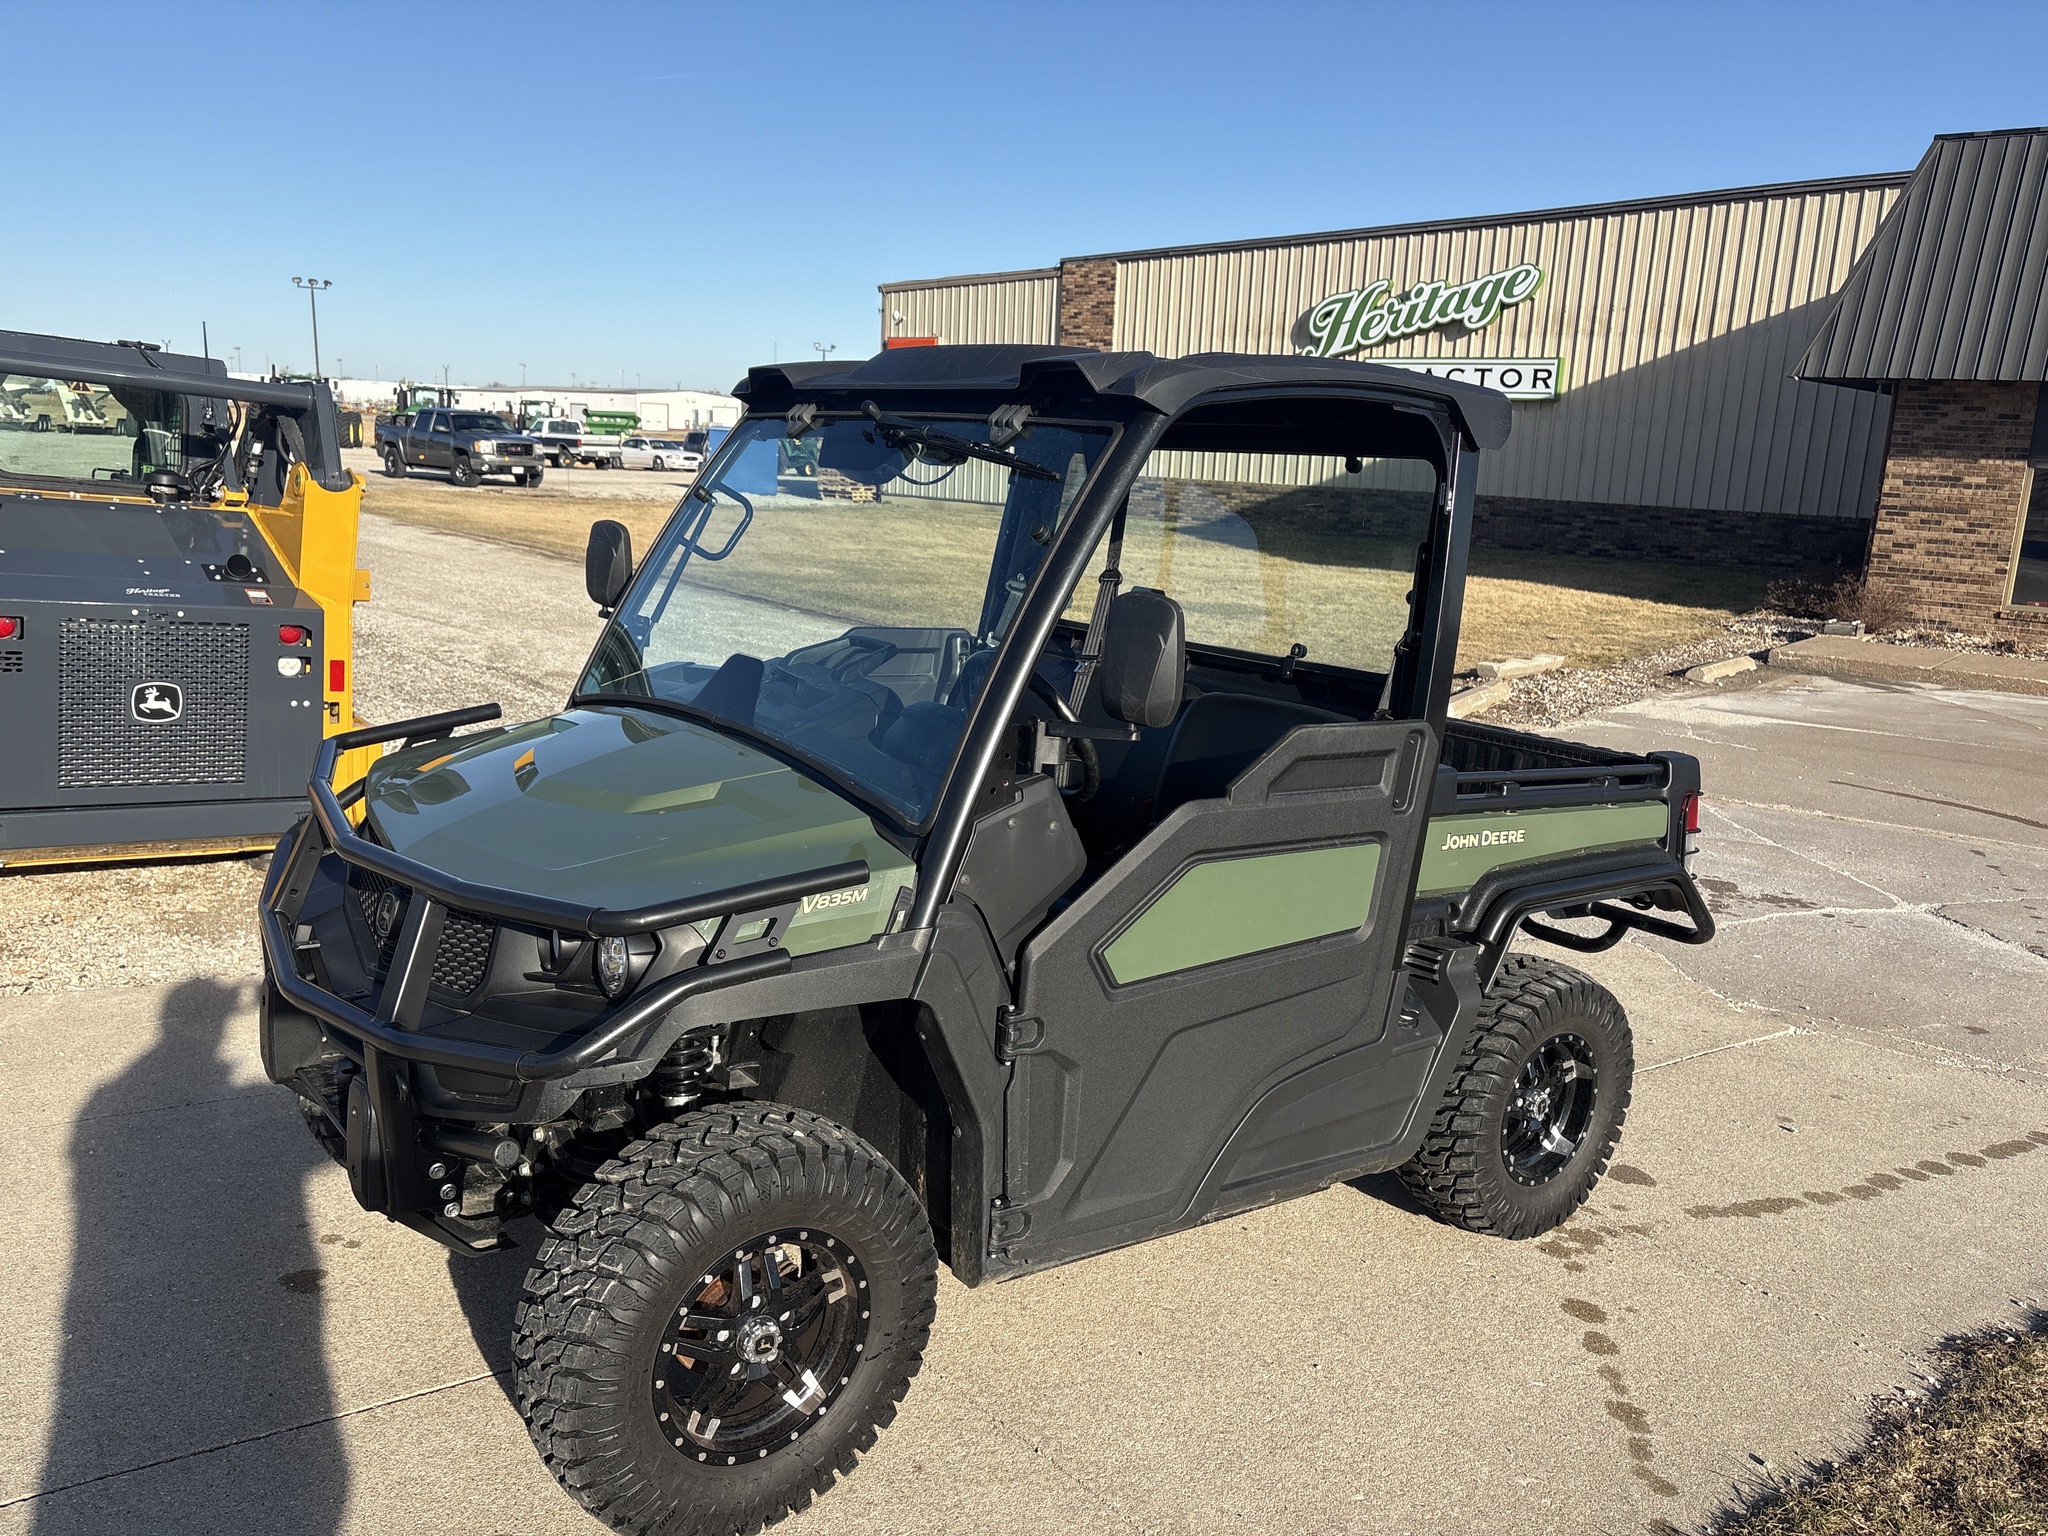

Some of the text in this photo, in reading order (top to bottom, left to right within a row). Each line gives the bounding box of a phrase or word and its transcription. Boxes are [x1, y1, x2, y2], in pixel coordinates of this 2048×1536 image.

[1304, 263, 1543, 357] Heritage
[1424, 367, 1554, 389] CTOR
[1441, 829, 1526, 851] JOHN DEERE
